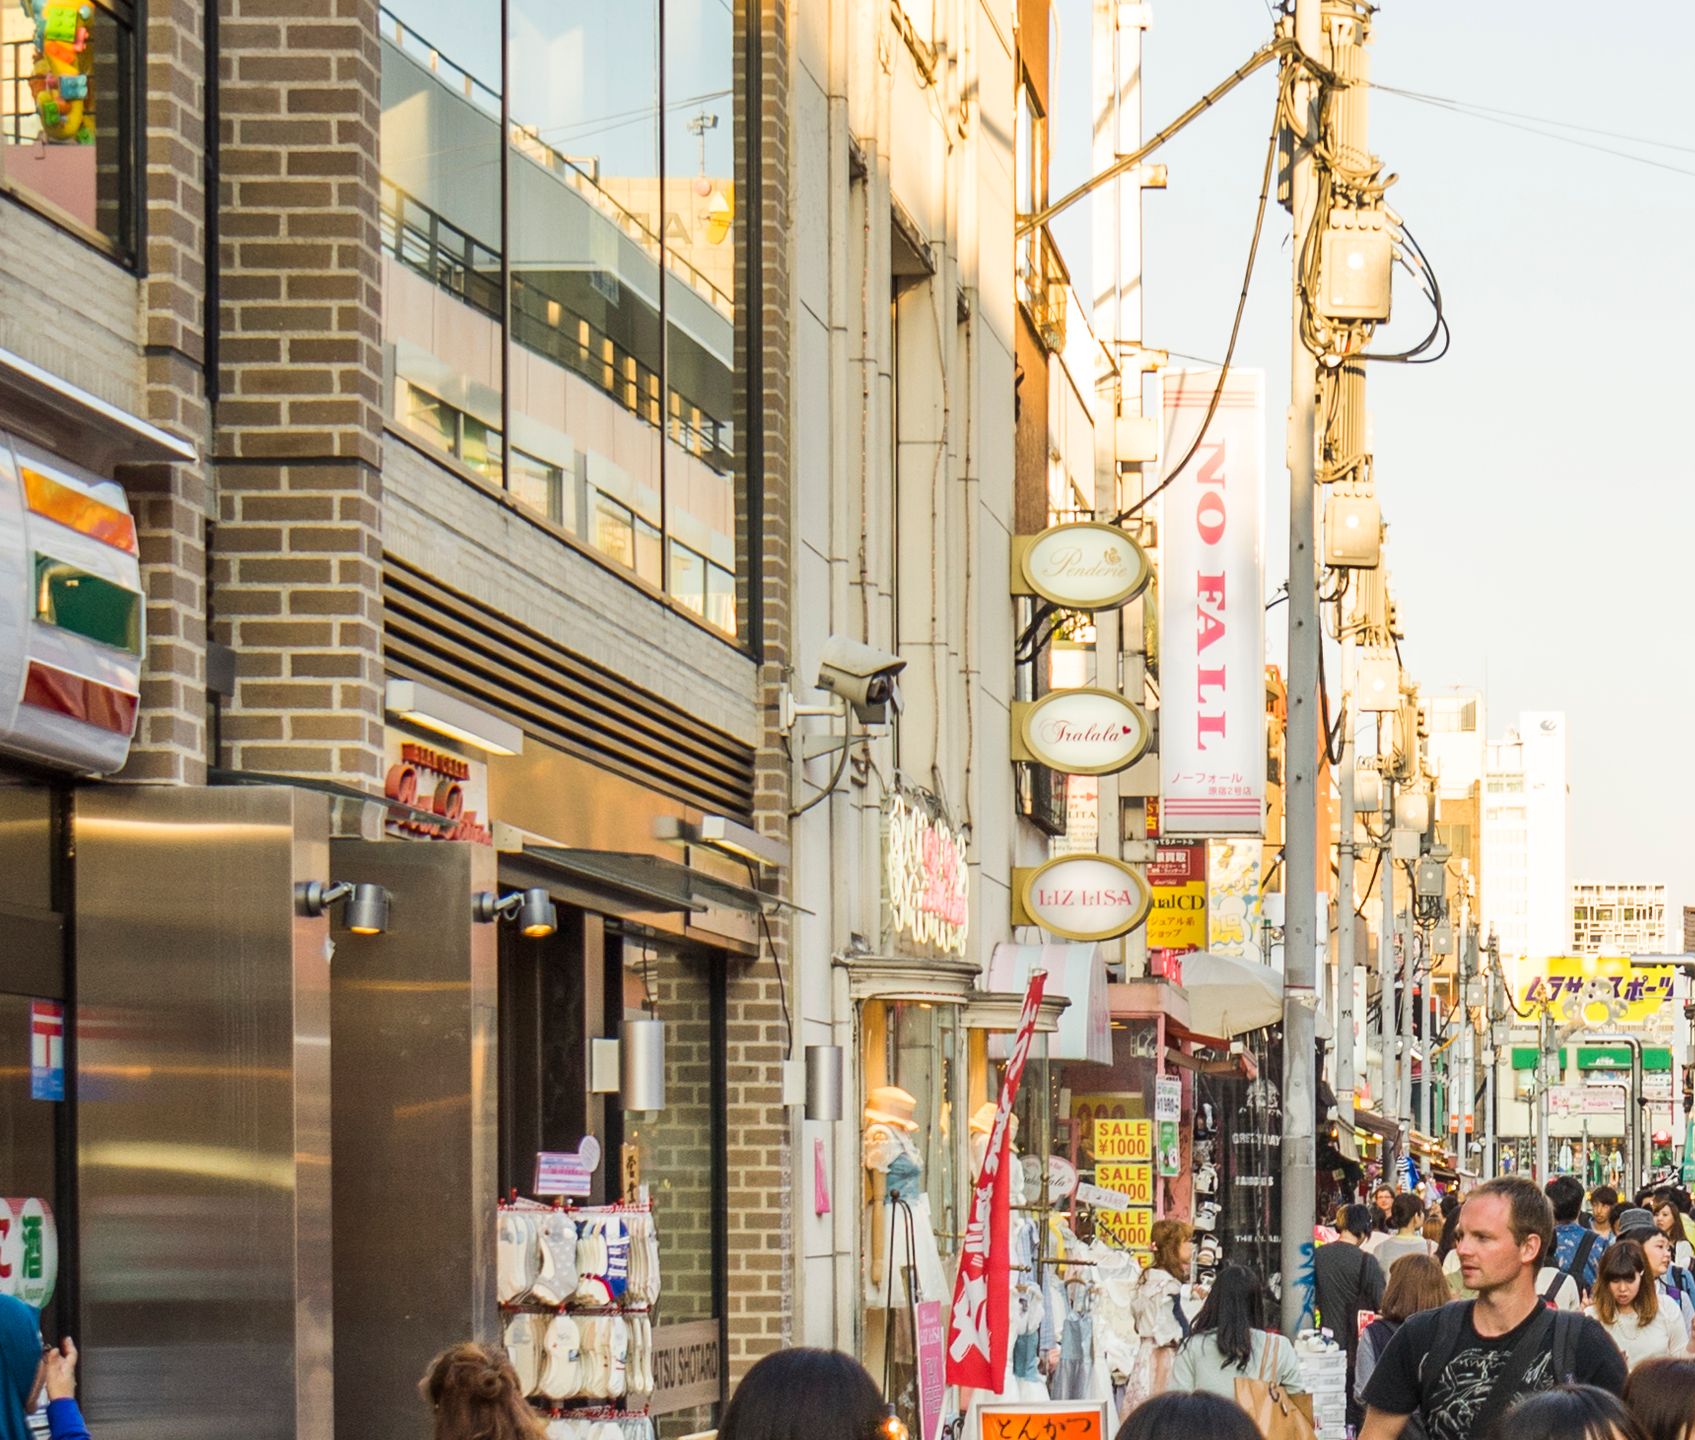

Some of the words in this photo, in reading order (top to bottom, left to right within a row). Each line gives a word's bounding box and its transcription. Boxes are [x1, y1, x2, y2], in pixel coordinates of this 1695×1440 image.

[1196, 437, 1227, 547] NO
[1196, 570, 1227, 753] FALL
[1171, 772, 1243, 784] ノーフォール
[1039, 890, 1075, 907] LIZ
[1081, 889, 1133, 907] LISA
[1099, 1122, 1149, 1137] SALE
[1099, 1138, 1146, 1156] ¥1000
[1099, 1167, 1149, 1181] SALE
[1099, 1212, 1149, 1226] SALE
